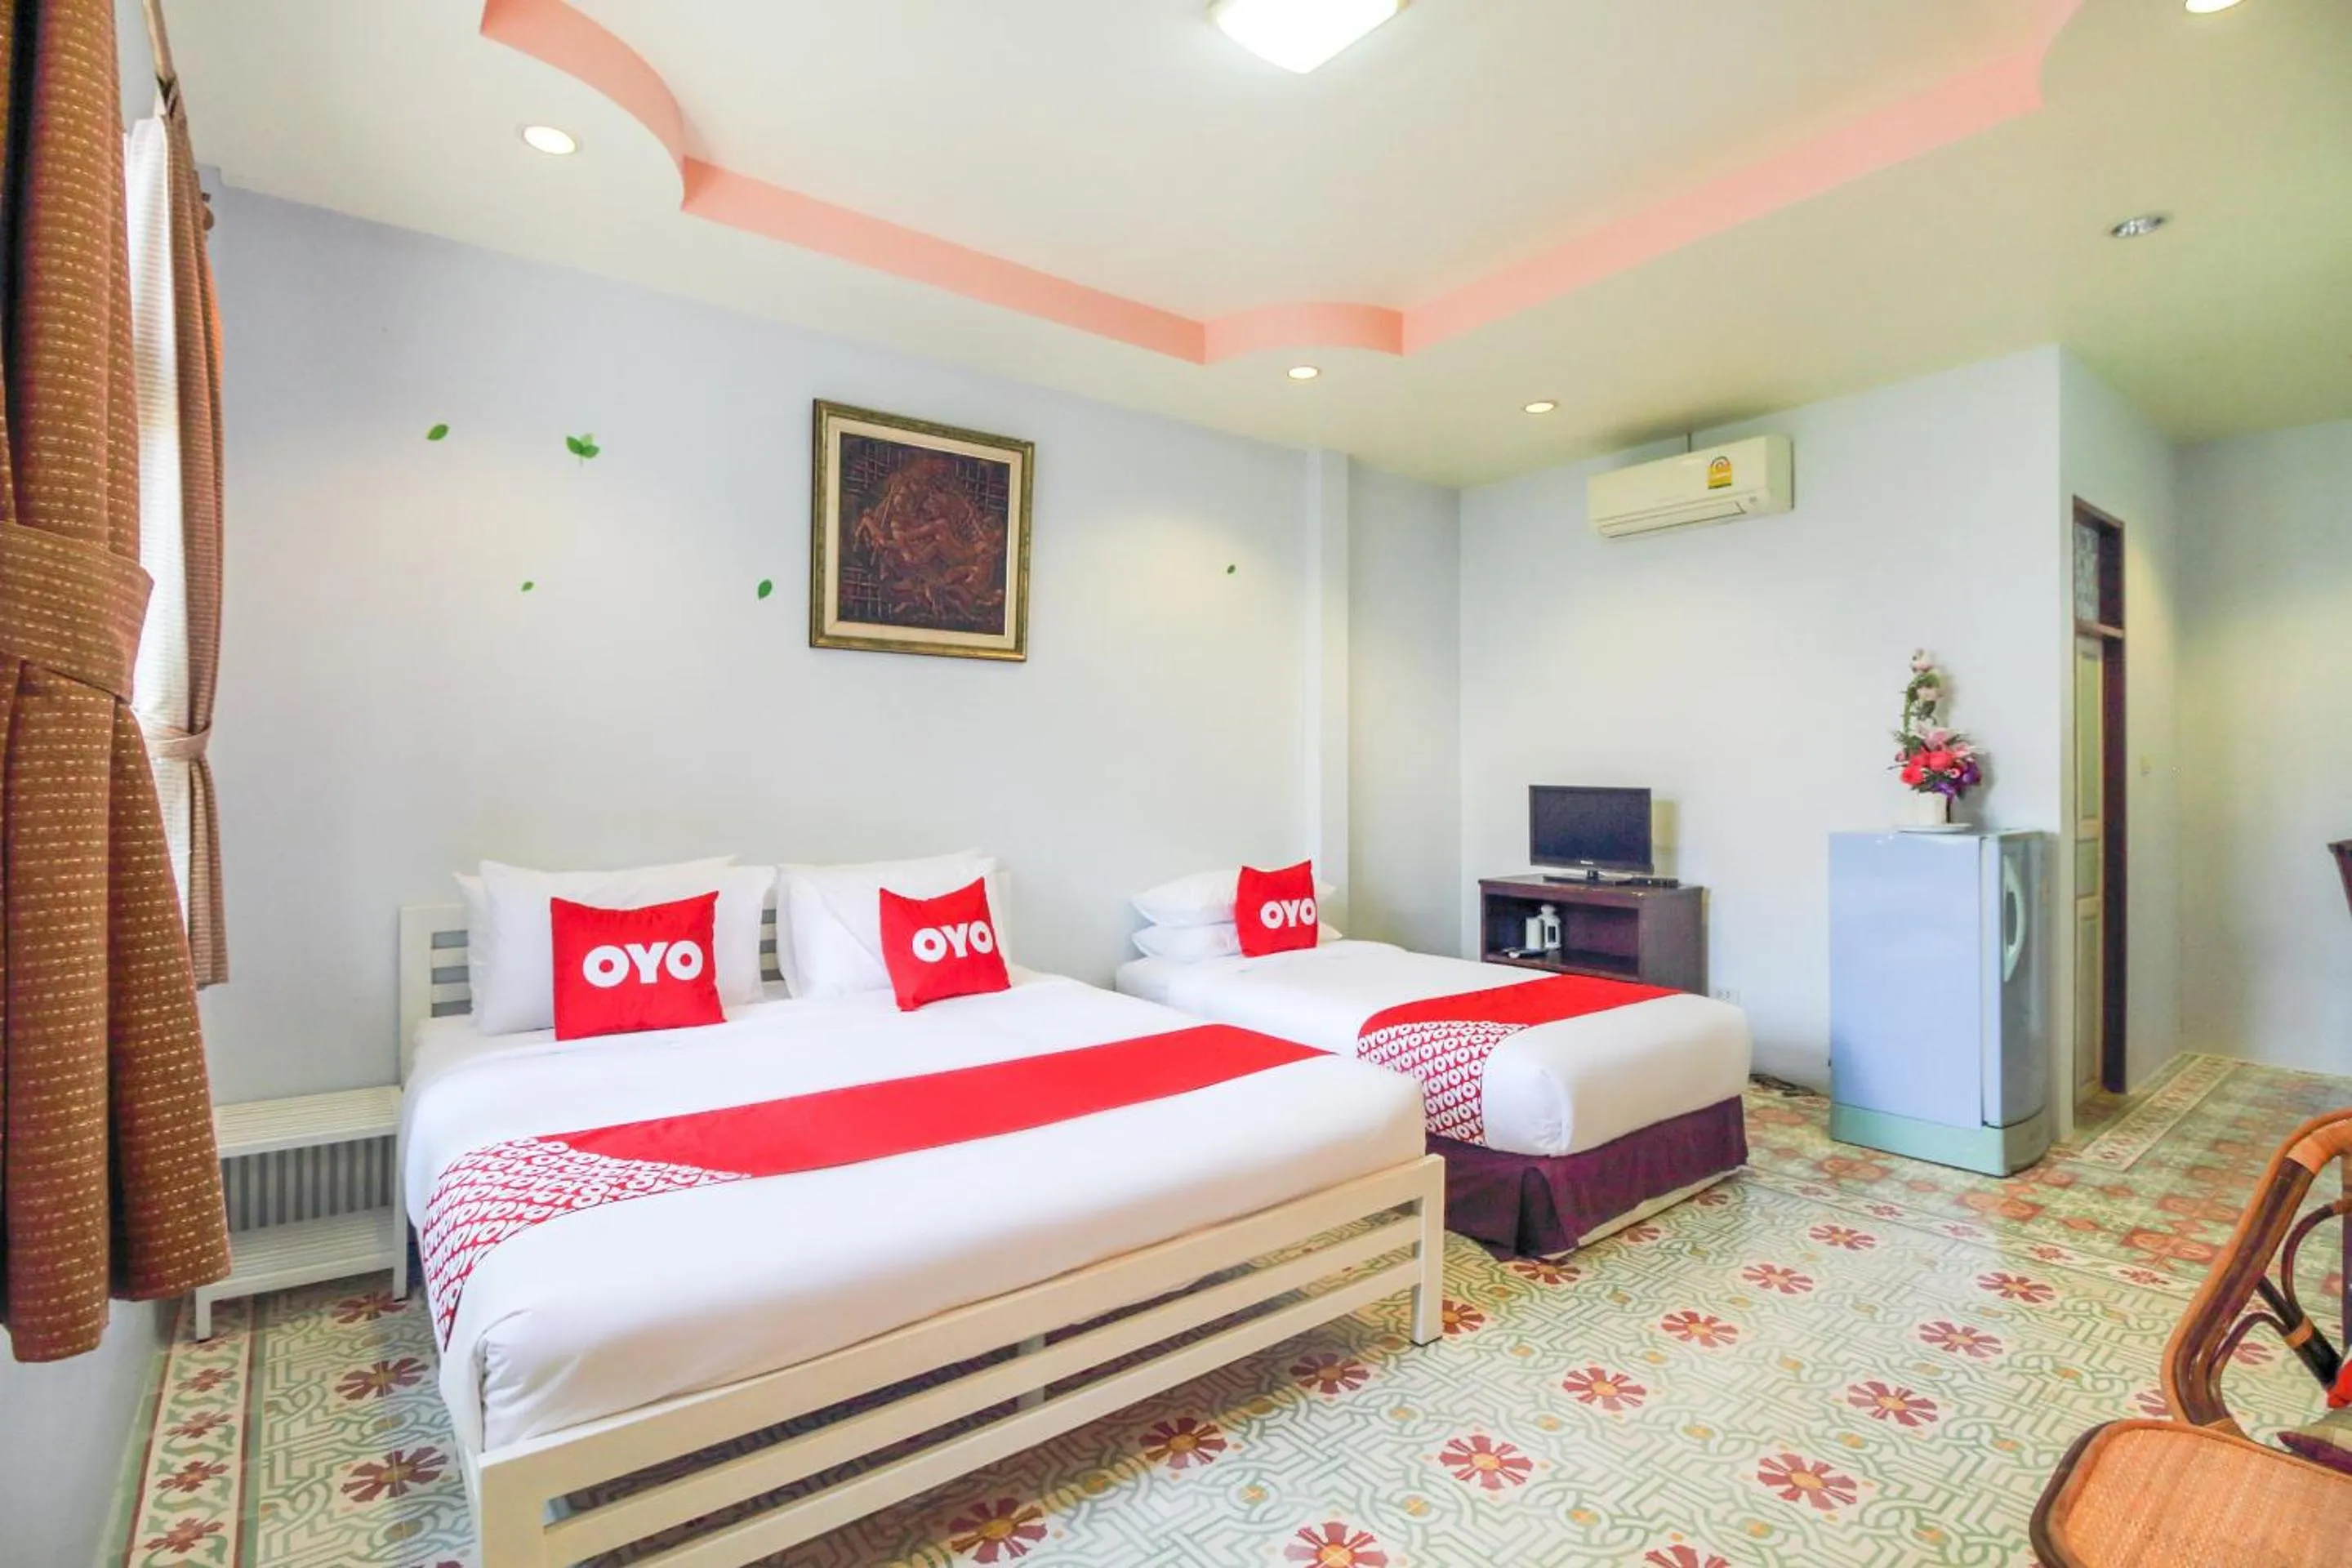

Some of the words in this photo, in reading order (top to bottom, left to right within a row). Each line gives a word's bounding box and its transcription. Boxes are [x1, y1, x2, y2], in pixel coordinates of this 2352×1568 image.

[1259, 898, 1316, 929] OYO
[912, 920, 993, 962] OYO
[583, 940, 703, 987] OYO
